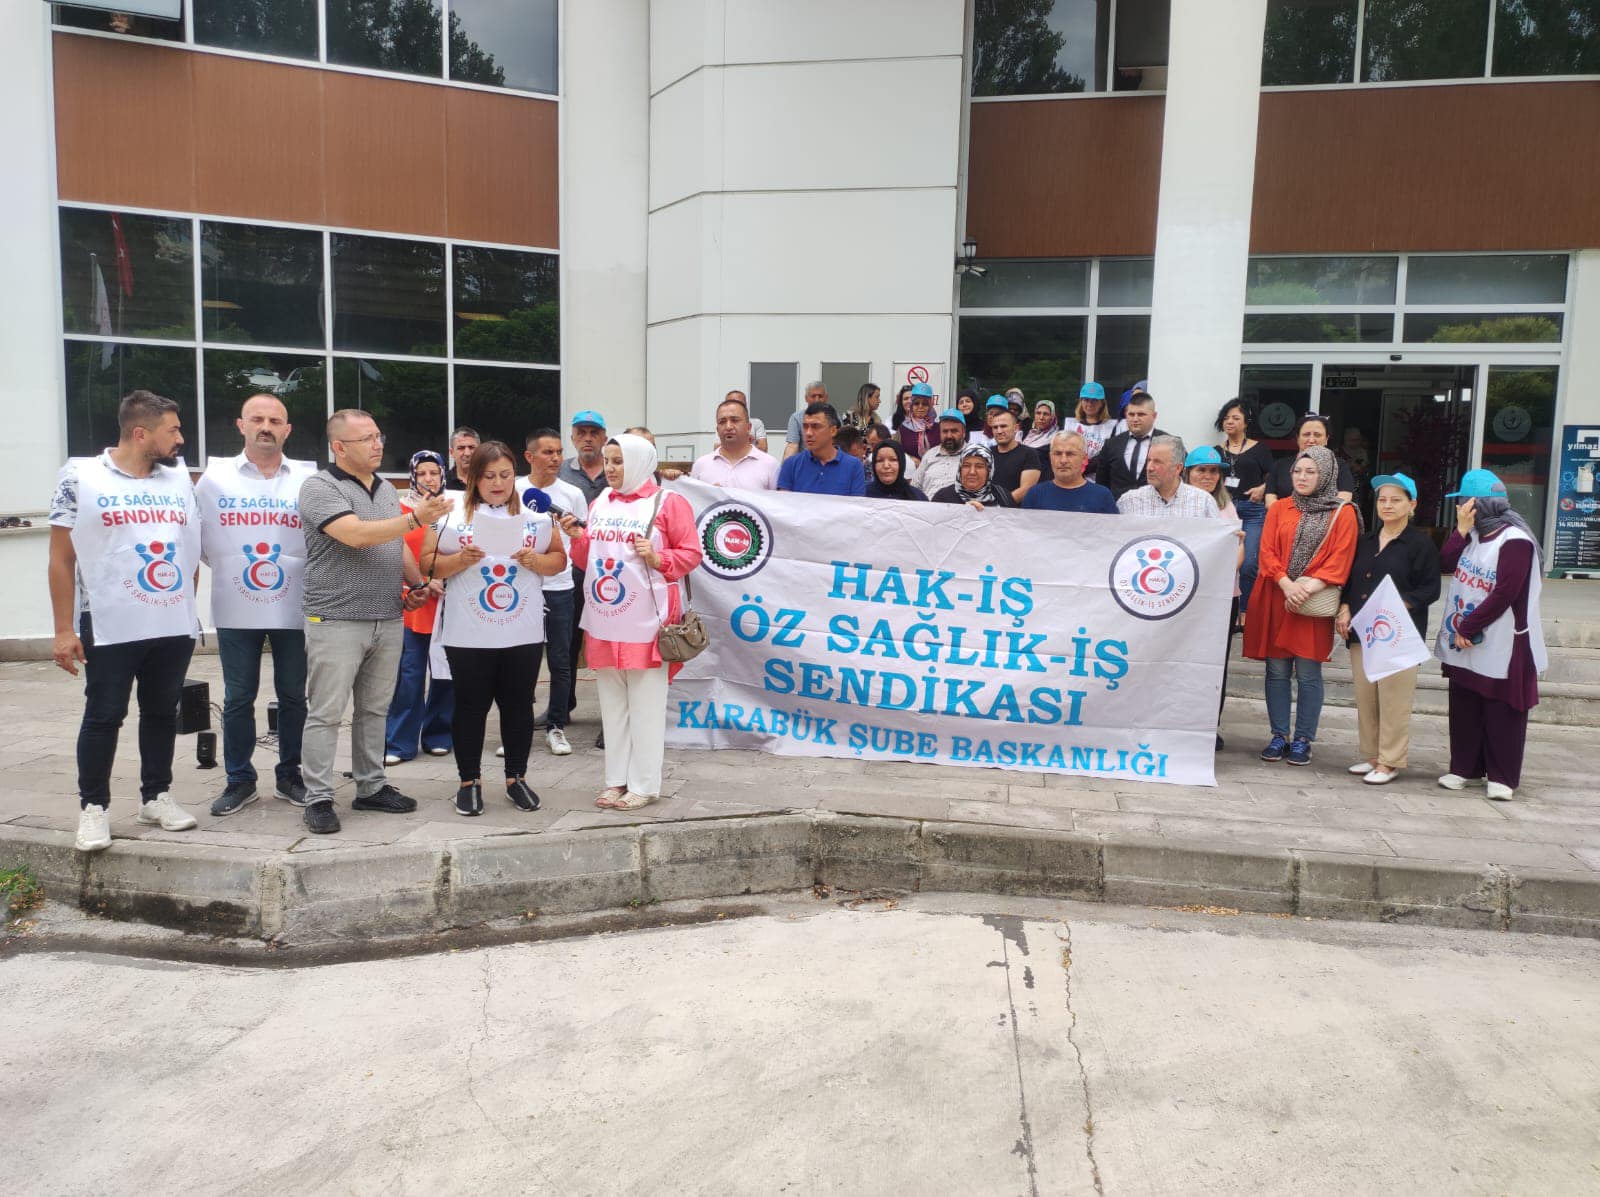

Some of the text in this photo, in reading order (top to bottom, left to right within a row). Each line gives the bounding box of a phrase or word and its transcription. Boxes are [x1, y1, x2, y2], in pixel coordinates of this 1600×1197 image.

[101, 507, 187, 527] SENDİKASI
[218, 494, 236, 508] ÖZ
[826, 559, 1035, 629] HAK-İŞ
[729, 593, 1129, 691] ÖZ SAĞLIK-İŞ
[763, 658, 1088, 727] SENDİKASI
[676, 700, 838, 747] KARABÜK
[847, 723, 938, 759] ŞUBE
